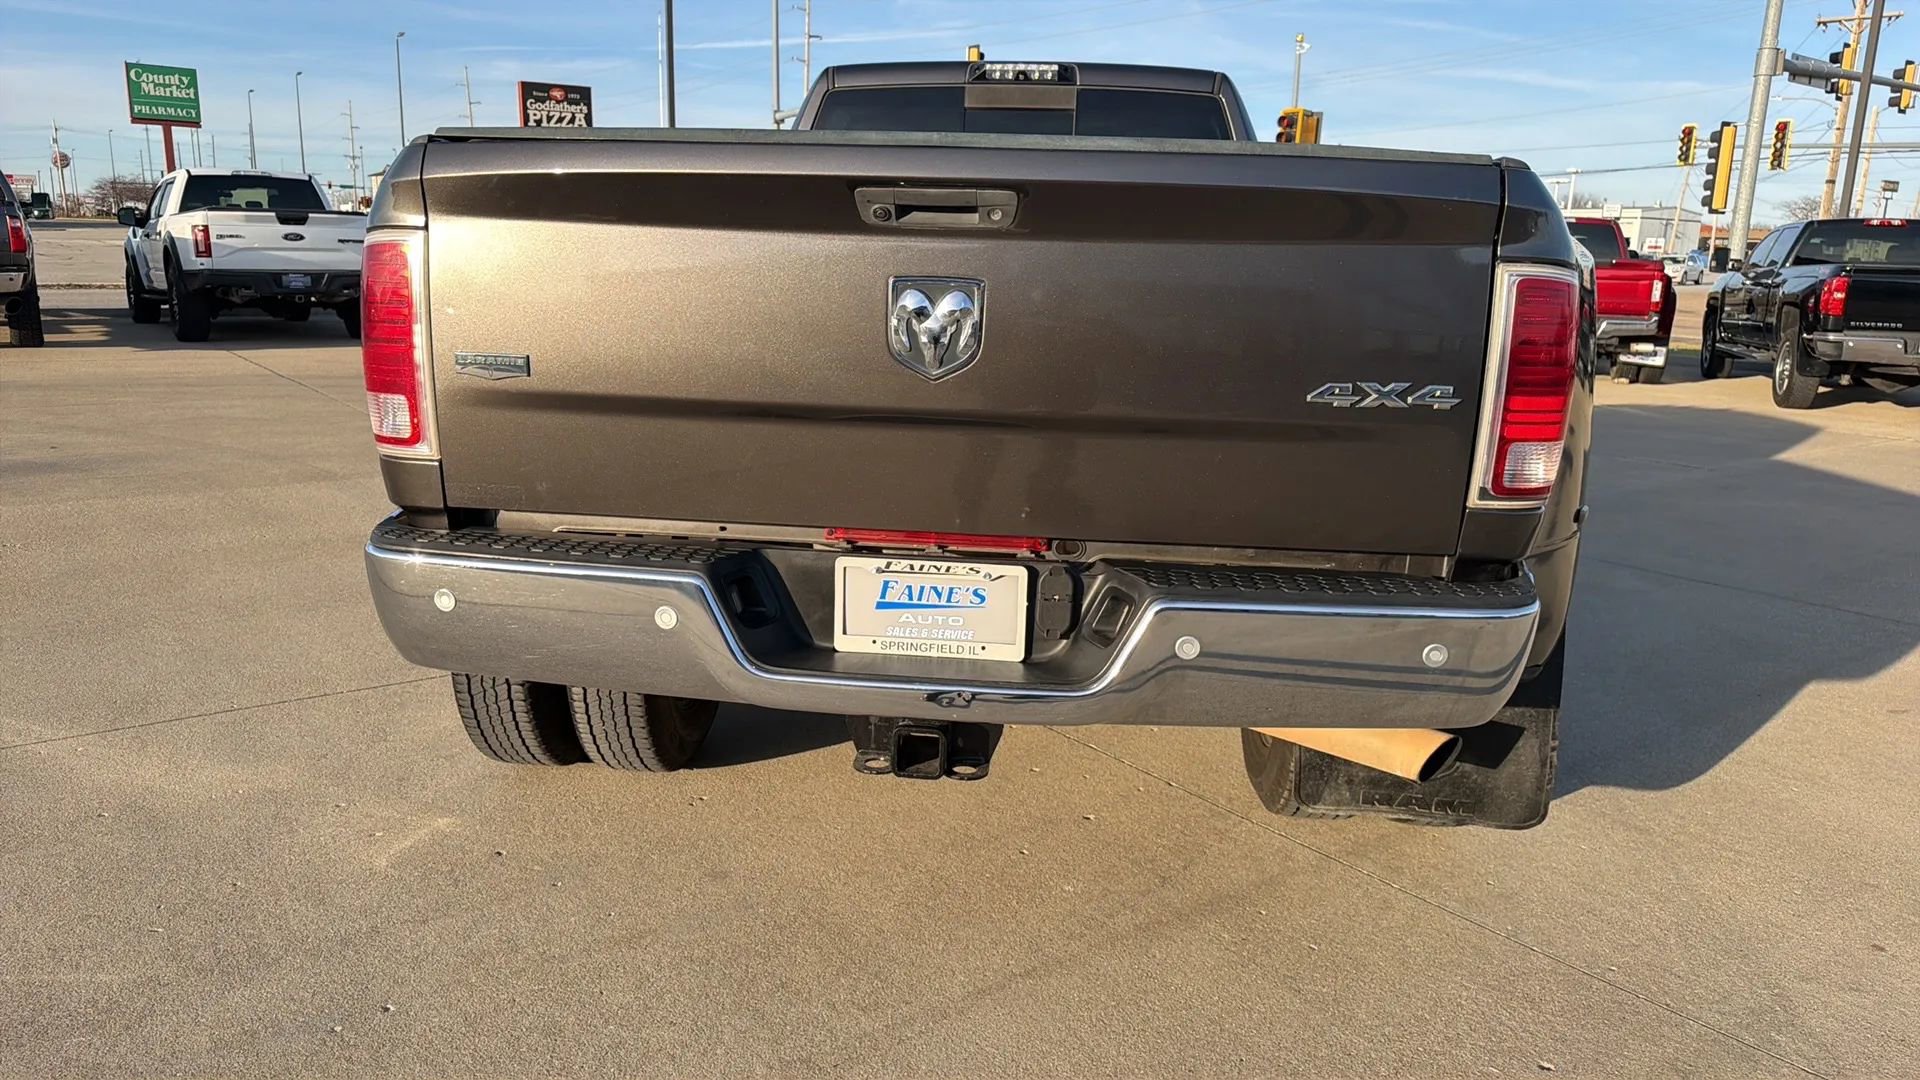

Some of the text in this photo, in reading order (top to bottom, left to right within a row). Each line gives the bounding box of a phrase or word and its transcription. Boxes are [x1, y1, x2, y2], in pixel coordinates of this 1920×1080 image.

[129, 68, 191, 88] County
[140, 82, 195, 99] Market
[133, 105, 197, 118] PHARMACY
[526, 98, 588, 113] Godfather's
[527, 110, 588, 127] PIZZA
[883, 561, 981, 575] FAINE'S
[878, 580, 987, 606] FAINE'S
[898, 613, 964, 626] AUTO
[886, 626, 976, 640] SALES & SERVICE
[880, 640, 979, 656] SPRINGFIELD IL
